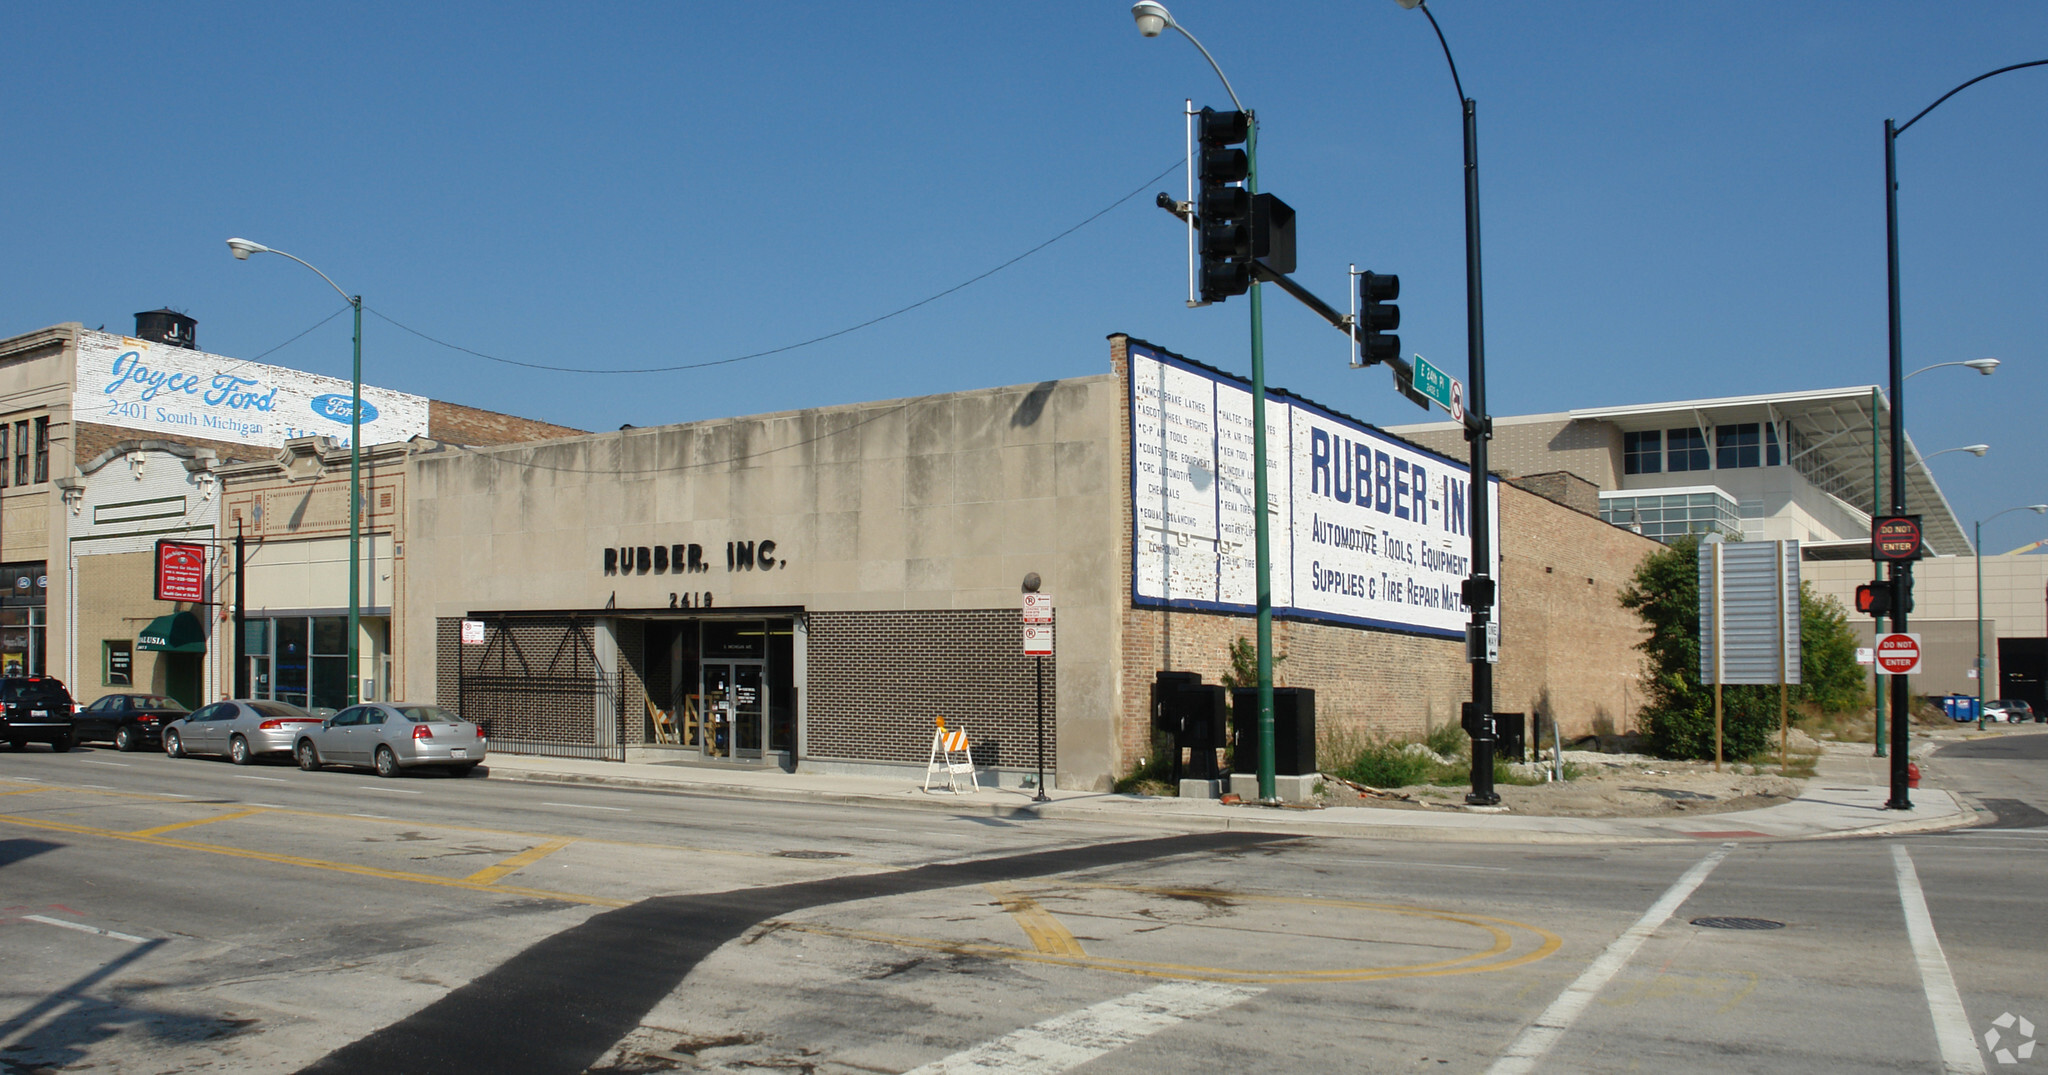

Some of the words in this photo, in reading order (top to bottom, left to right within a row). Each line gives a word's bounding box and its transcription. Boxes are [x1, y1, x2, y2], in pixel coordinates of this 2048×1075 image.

[1421, 363, 1425, 376] E
[104, 351, 199, 402] Joyce
[204, 375, 278, 412] Ford
[1164, 392, 1182, 406] BRAKE
[1185, 399, 1205, 413] LATHES
[108, 399, 148, 419] 2401
[156, 408, 197, 426] South
[202, 414, 263, 436] Michigan
[1143, 405, 1160, 418] ASCOT
[1164, 412, 1182, 425] WHEEL
[1185, 418, 1208, 432] WEIGHTS
[1222, 411, 1241, 424] HALTEC
[1244, 418, 1253, 428] TIR
[1143, 424, 1153, 435] C-P
[1157, 428, 1166, 438] AIR
[1170, 431, 1187, 444] TOOLS
[1244, 435, 1254, 445] TOO
[1143, 444, 1162, 456] COATS
[1166, 449, 1178, 461] TIRE
[1181, 454, 1210, 469] EQUIPMENT
[1236, 450, 1248, 461] TOOL
[1143, 462, 1154, 473] CRC
[1159, 467, 1192, 482] AUTOMOTIVE
[1149, 484, 1180, 499] CHEMICALS
[1225, 501, 1237, 512] REMA
[1240, 504, 1250, 514] TIRE
[1144, 508, 1163, 520] EQUAL
[1166, 512, 1196, 527] BALANCING
[1149, 542, 1179, 556] COMPOUND
[1312, 512, 1377, 555] AUTOMOTIVE
[1382, 530, 1417, 568] TOOLS,
[1312, 560, 1364, 598] SUPPLIES
[1369, 577, 1376, 600] &
[1382, 572, 1403, 603] TIRE
[1407, 577, 1439, 608] REPAIR
[1488, 626, 1496, 635] ONE
[1488, 637, 1496, 646] WAY
